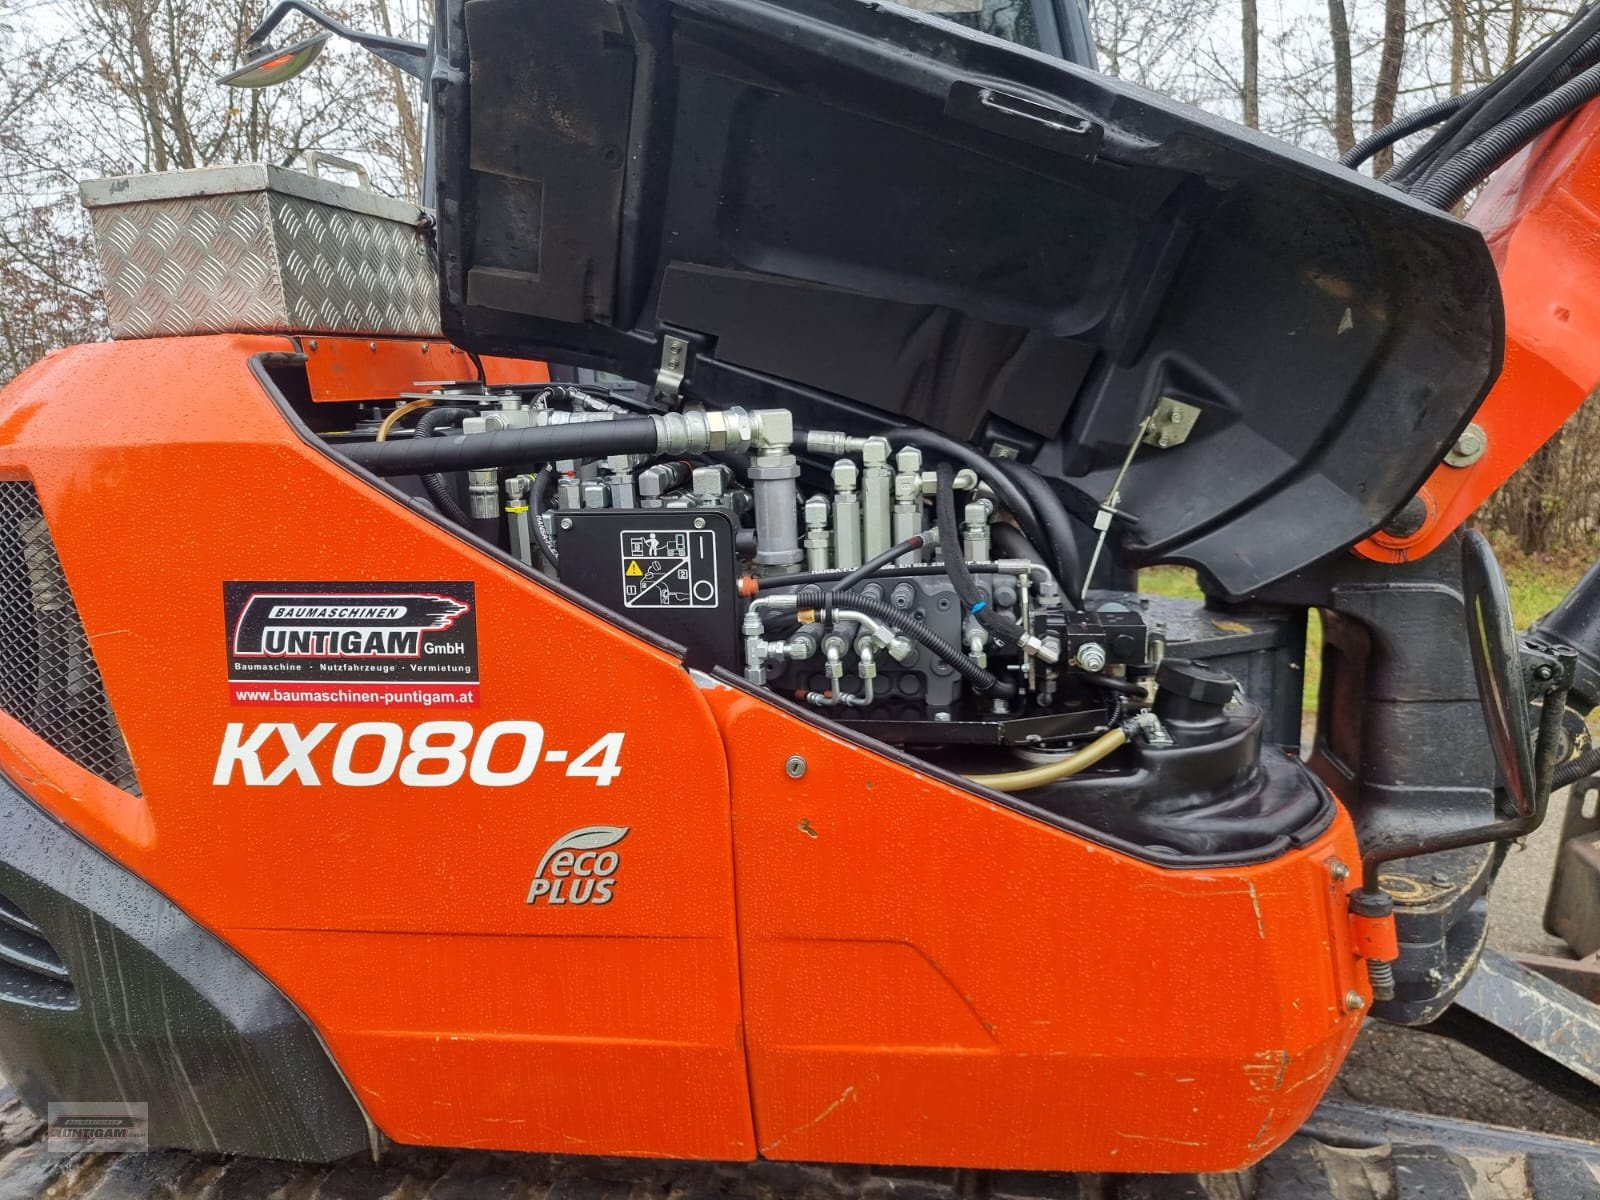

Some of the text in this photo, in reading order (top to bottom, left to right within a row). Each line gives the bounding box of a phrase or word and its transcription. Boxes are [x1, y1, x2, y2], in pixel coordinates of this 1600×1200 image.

[274, 606, 400, 618] BAUMASCHINEN
[423, 641, 465, 655] GmbH
[234, 662, 472, 674] Baumaschine Nutzfahrzeuge Vermietung
[235, 688, 474, 707] www.baumaschinen-puntigam.at
[212, 720, 625, 787] KX080-4
[549, 850, 619, 877] eco
[525, 878, 614, 906] PLUS
